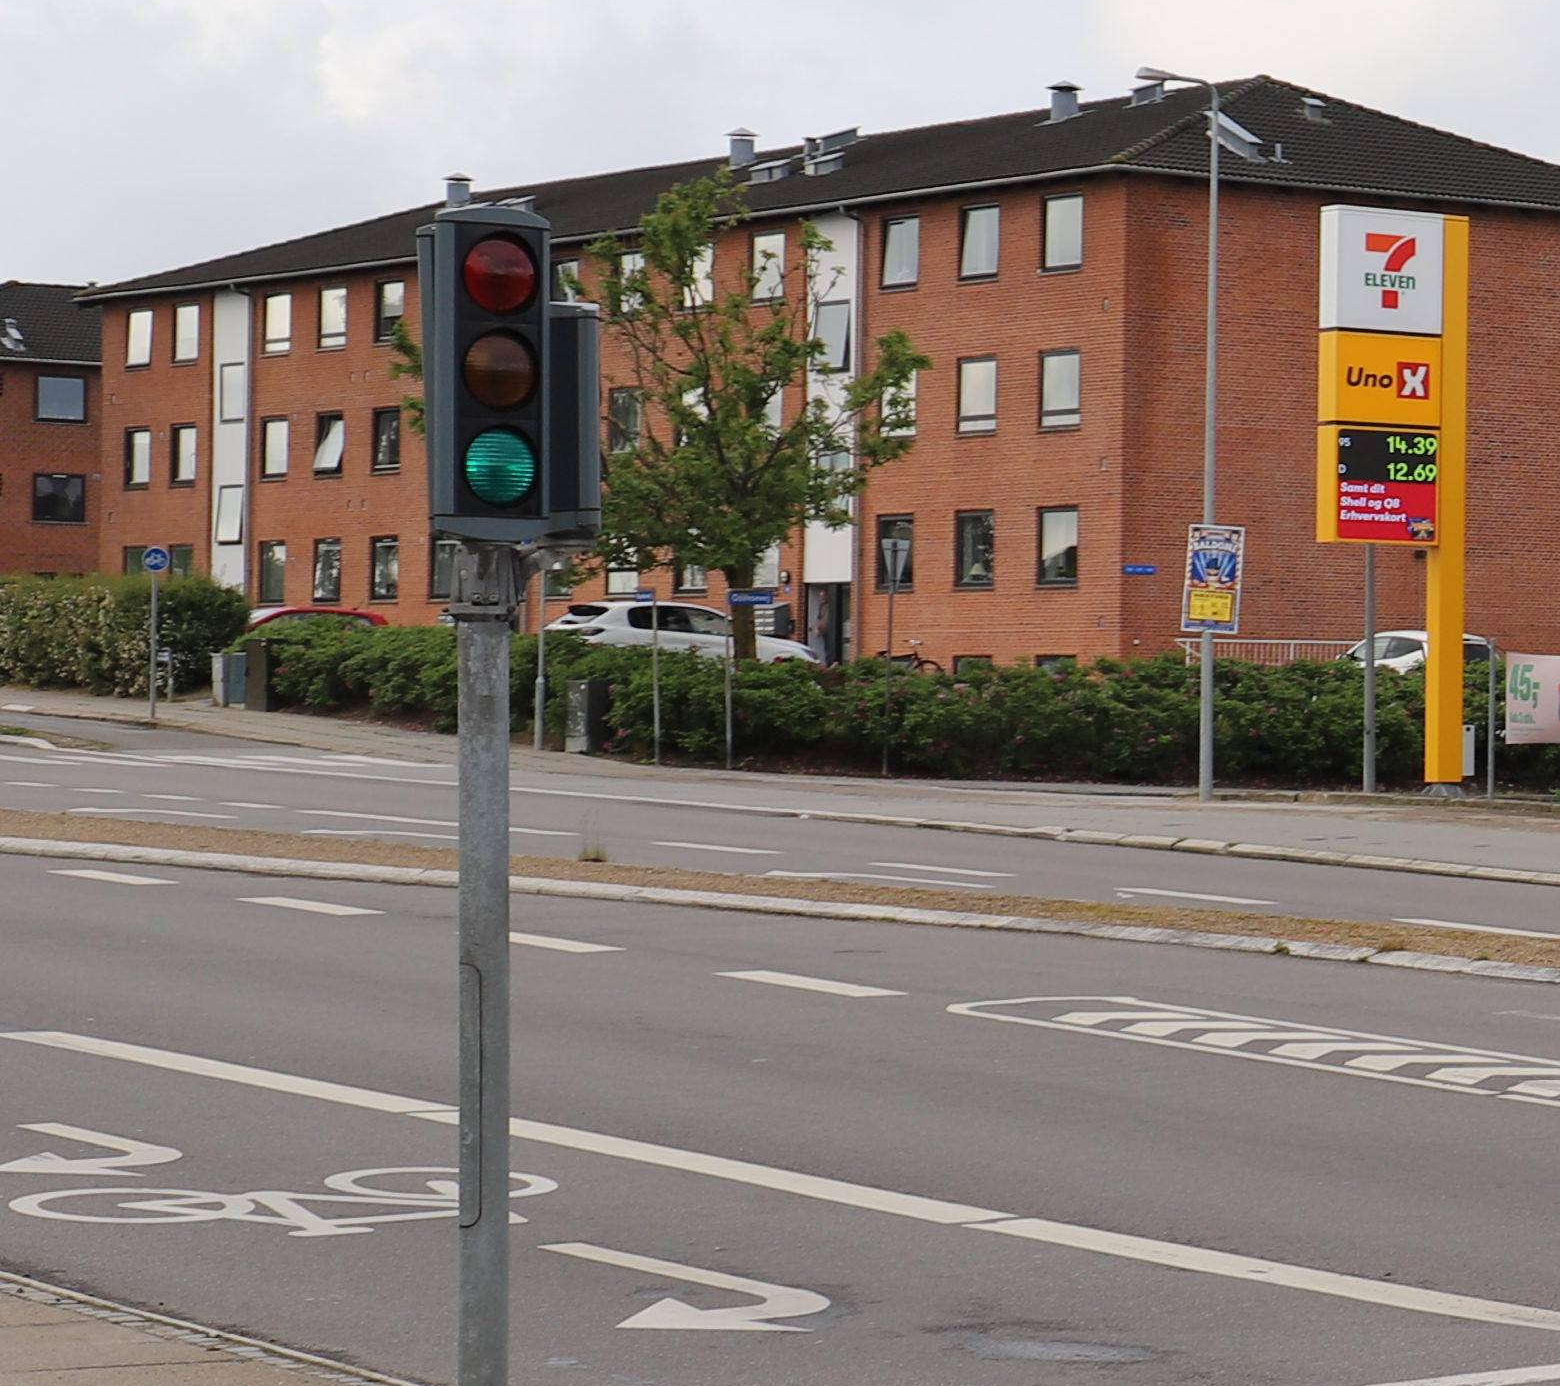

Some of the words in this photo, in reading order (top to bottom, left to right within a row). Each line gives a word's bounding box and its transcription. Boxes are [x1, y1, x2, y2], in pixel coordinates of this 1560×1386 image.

[1366, 232, 1416, 309] 7
[1346, 365, 1393, 389] Uno
[1401, 365, 1427, 397] X
[1386, 435, 1437, 455] 14.39
[1386, 462, 1437, 481] 12.69
[1340, 482, 1368, 492] Samt
[1370, 483, 1385, 493] dit
[1340, 496, 1367, 507] Shell
[1368, 499, 1382, 510] og
[1384, 498, 1400, 509] Q8
[1340, 510, 1407, 522] Erhvervskort
